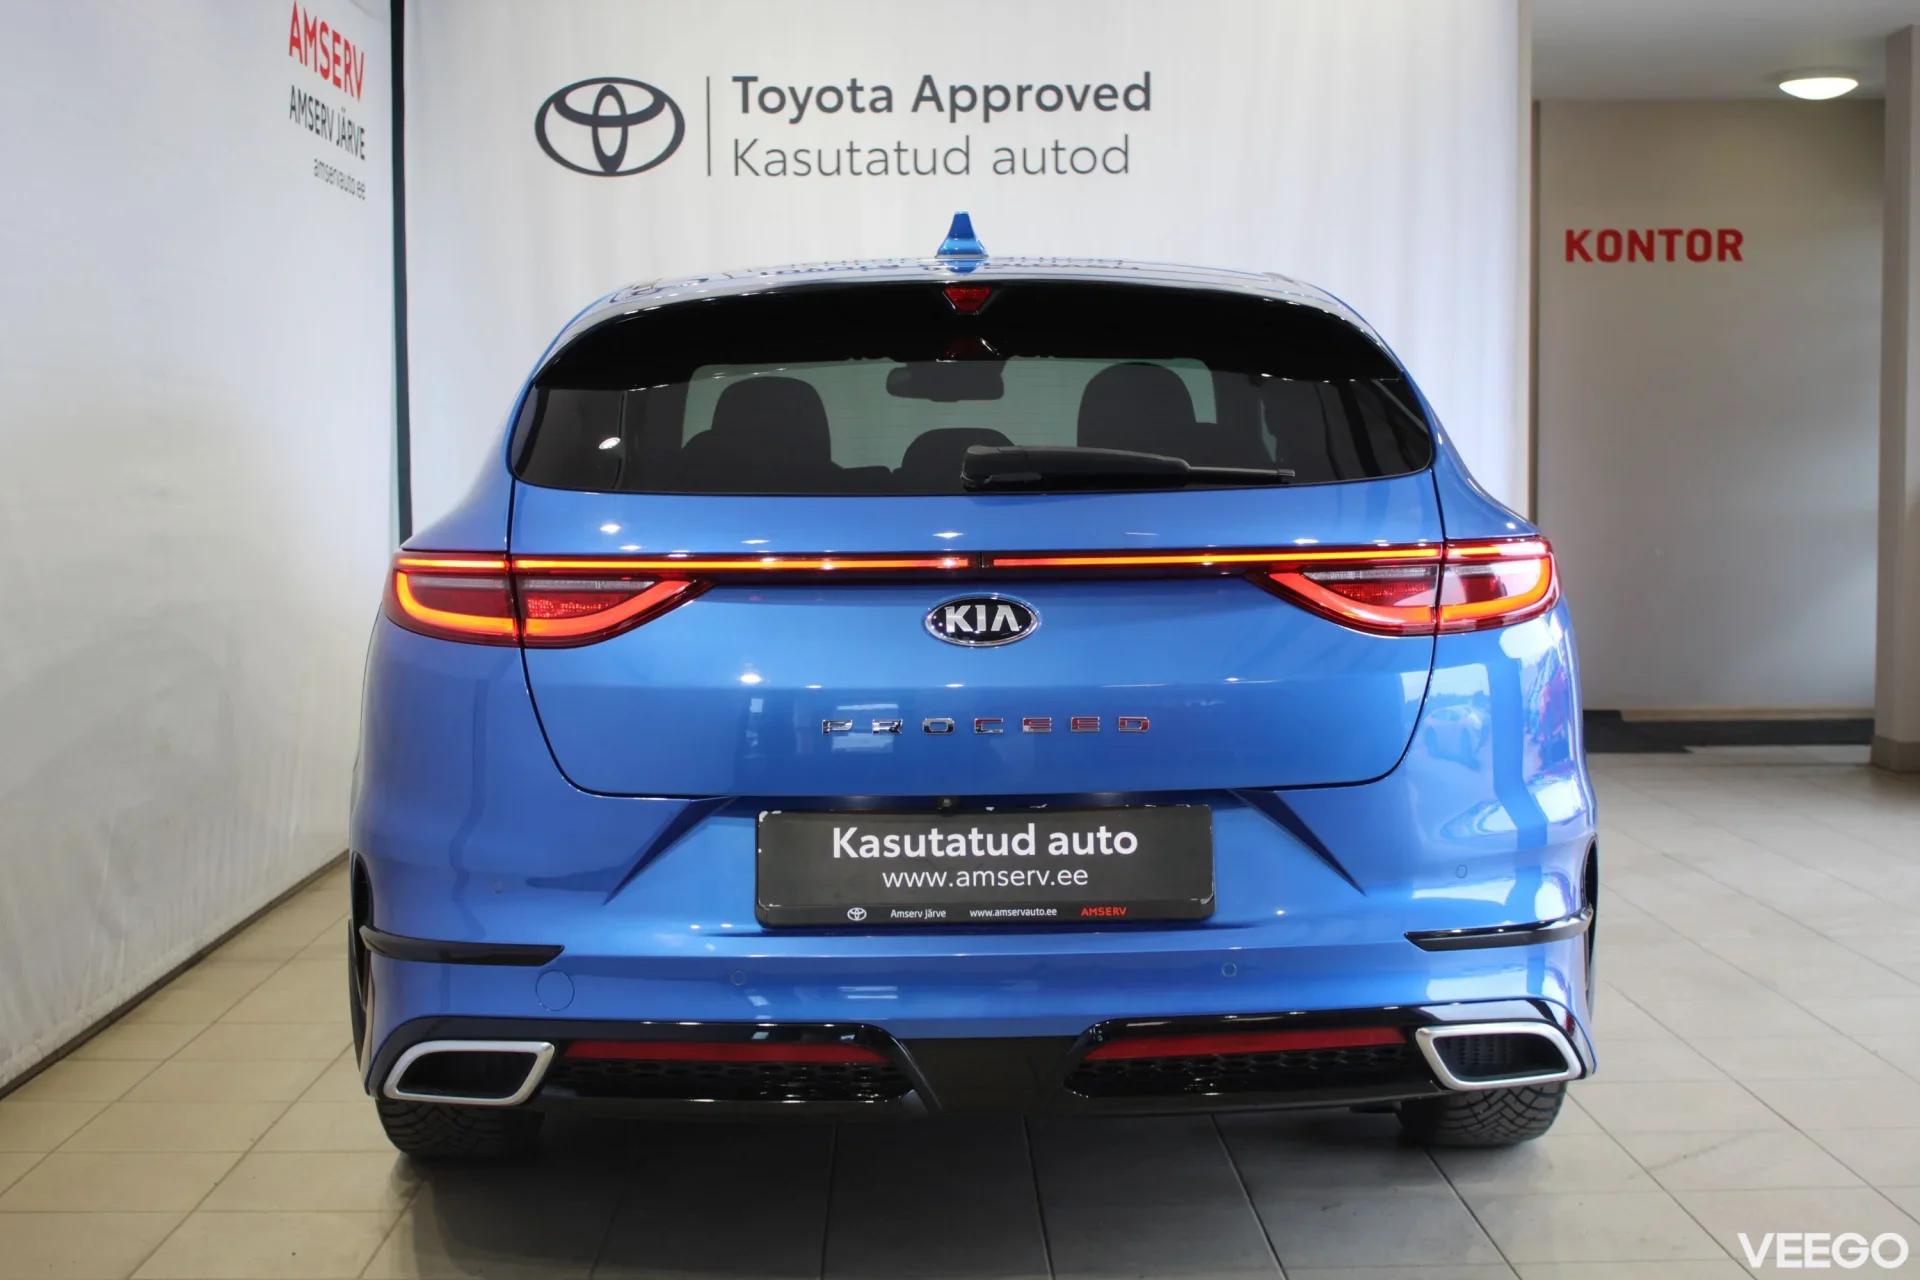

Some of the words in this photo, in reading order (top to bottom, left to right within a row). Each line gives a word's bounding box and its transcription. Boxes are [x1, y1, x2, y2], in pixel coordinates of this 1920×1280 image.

[289, 0, 364, 102] AMSERV
[732, 75, 894, 123] Toyota
[911, 72, 1152, 123] Approved
[289, 84, 334, 142] AMSERV
[336, 107, 365, 160] JÄRVE
[733, 135, 970, 177] Kasutatud
[992, 134, 1130, 175] autod
[313, 158, 366, 200] amservauto.ee
[1565, 228, 1744, 263] KONTOR
[945, 604, 1020, 633] KIA
[821, 716, 1150, 735] PROCEED
[832, 823, 1036, 859] Kasutatud
[1048, 826, 1139, 855] auto
[882, 865, 1089, 888] www.amserv.ee
[890, 908, 921, 919] Amserv
[923, 907, 947, 919] Järve
[969, 907, 1058, 918] www.amservauto.ee
[1080, 906, 1127, 917] AMSERV
